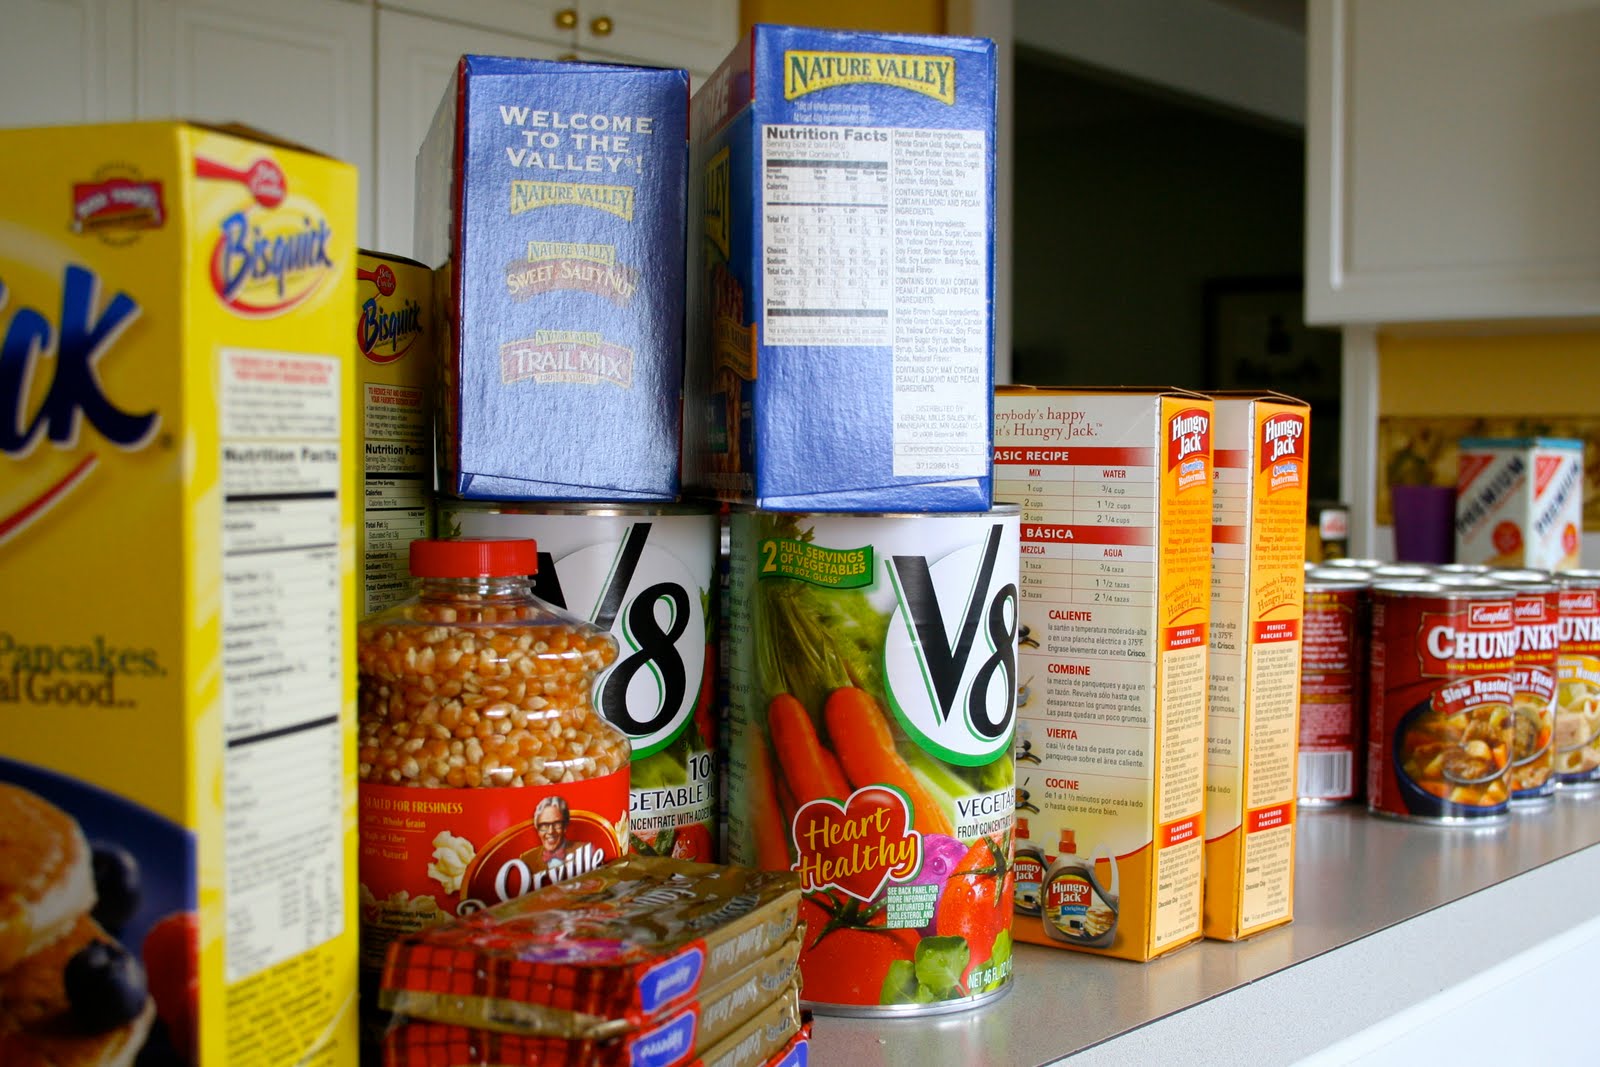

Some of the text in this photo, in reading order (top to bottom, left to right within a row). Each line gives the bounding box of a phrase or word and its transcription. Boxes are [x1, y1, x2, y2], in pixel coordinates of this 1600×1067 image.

[790, 56, 950, 96] NATURE VALLEY
[500, 105, 653, 135] WELCOME
[767, 128, 888, 142] Nutrition Facts
[522, 131, 630, 153] TO THE
[514, 183, 633, 212] NATURE VALLEY
[220, 212, 333, 298] Bisquick
[531, 242, 614, 262] NATURE VALLEY
[507, 261, 635, 297] SWEET SALTY NUT
[362, 298, 423, 352] Bisquick
[511, 350, 624, 380] TRAIL MIX
[1047, 407, 1086, 424] happy
[996, 425, 1010, 436] it's
[1014, 424, 1063, 441] Hungry
[1172, 415, 1208, 441] Hungry
[1266, 418, 1303, 444] Hungry
[366, 444, 403, 455] Nutrition
[1178, 434, 1201, 461] Jack
[1271, 436, 1295, 462] Jack
[225, 446, 338, 463] Nutrition Facts
[1027, 451, 1069, 461] RECIPE
[1029, 469, 1126, 479] MIX WATER
[1026, 527, 1073, 539] BÁSICA
[763, 541, 777, 573] 2
[780, 542, 864, 564] FULL SERVINGS
[1021, 546, 1122, 557] MEZCLA AGUA
[780, 552, 866, 575] OF VEGETABLES
[781, 566, 794, 574] PER
[1049, 610, 1092, 621] CALIENTE
[892, 524, 1018, 738] V8
[1053, 624, 1070, 632] sartén
[1075, 625, 1107, 635] temperatura
[1108, 627, 1147, 636] moderada-alta
[1177, 628, 1195, 637] PERFECT
[1267, 623, 1286, 631] PERFECT
[1072, 635, 1095, 644] plancha
[1171, 637, 1191, 647] PANCAKE
[1260, 632, 1281, 640] PANCAKE
[1048, 644, 1069, 653] Engrase
[1070, 645, 1097, 655] levemente
[1109, 647, 1127, 656] aceite
[1048, 664, 1090, 676] COMBINE
[1442, 684, 1471, 704] Slow
[1047, 728, 1078, 740] VIERTA
[1067, 742, 1075, 750] de
[1075, 744, 1088, 752] taza
[1089, 744, 1097, 752] de
[1098, 747, 1115, 755] pasta
[1116, 748, 1127, 757] por
[1128, 748, 1144, 757] cada
[1046, 754, 1078, 764] panqueque
[1079, 755, 1096, 764] sobre
[1097, 756, 1102, 764] el
[1046, 778, 1079, 790] COCINE
[393, 800, 410, 812] FOR
[412, 801, 463, 814] FRESHNESS
[677, 812, 693, 825] WITH
[1259, 809, 1282, 819] FLAVORED
[406, 818, 425, 828] Grain
[958, 815, 1011, 838] FROM CONCENTRATE
[1171, 822, 1193, 833] FLAVORED
[1258, 817, 1281, 828] PANCAKES
[803, 807, 891, 851] Heart
[1171, 830, 1193, 842] PANCAKES
[800, 835, 915, 887] Healthy
[495, 842, 604, 900] Orville
[1015, 872, 1034, 881] Jack
[888, 885, 938, 895] SEE BACK PANEL FOR
[1053, 882, 1089, 894] Hungry
[888, 894, 937, 903] MORE INFORMATION
[1058, 893, 1081, 904] Jack
[897, 903, 924, 911] SATURATED
[887, 910, 934, 920] CHOLESTEROL AND
[887, 920, 903, 928] HEART
[968, 974, 983, 988] NET
